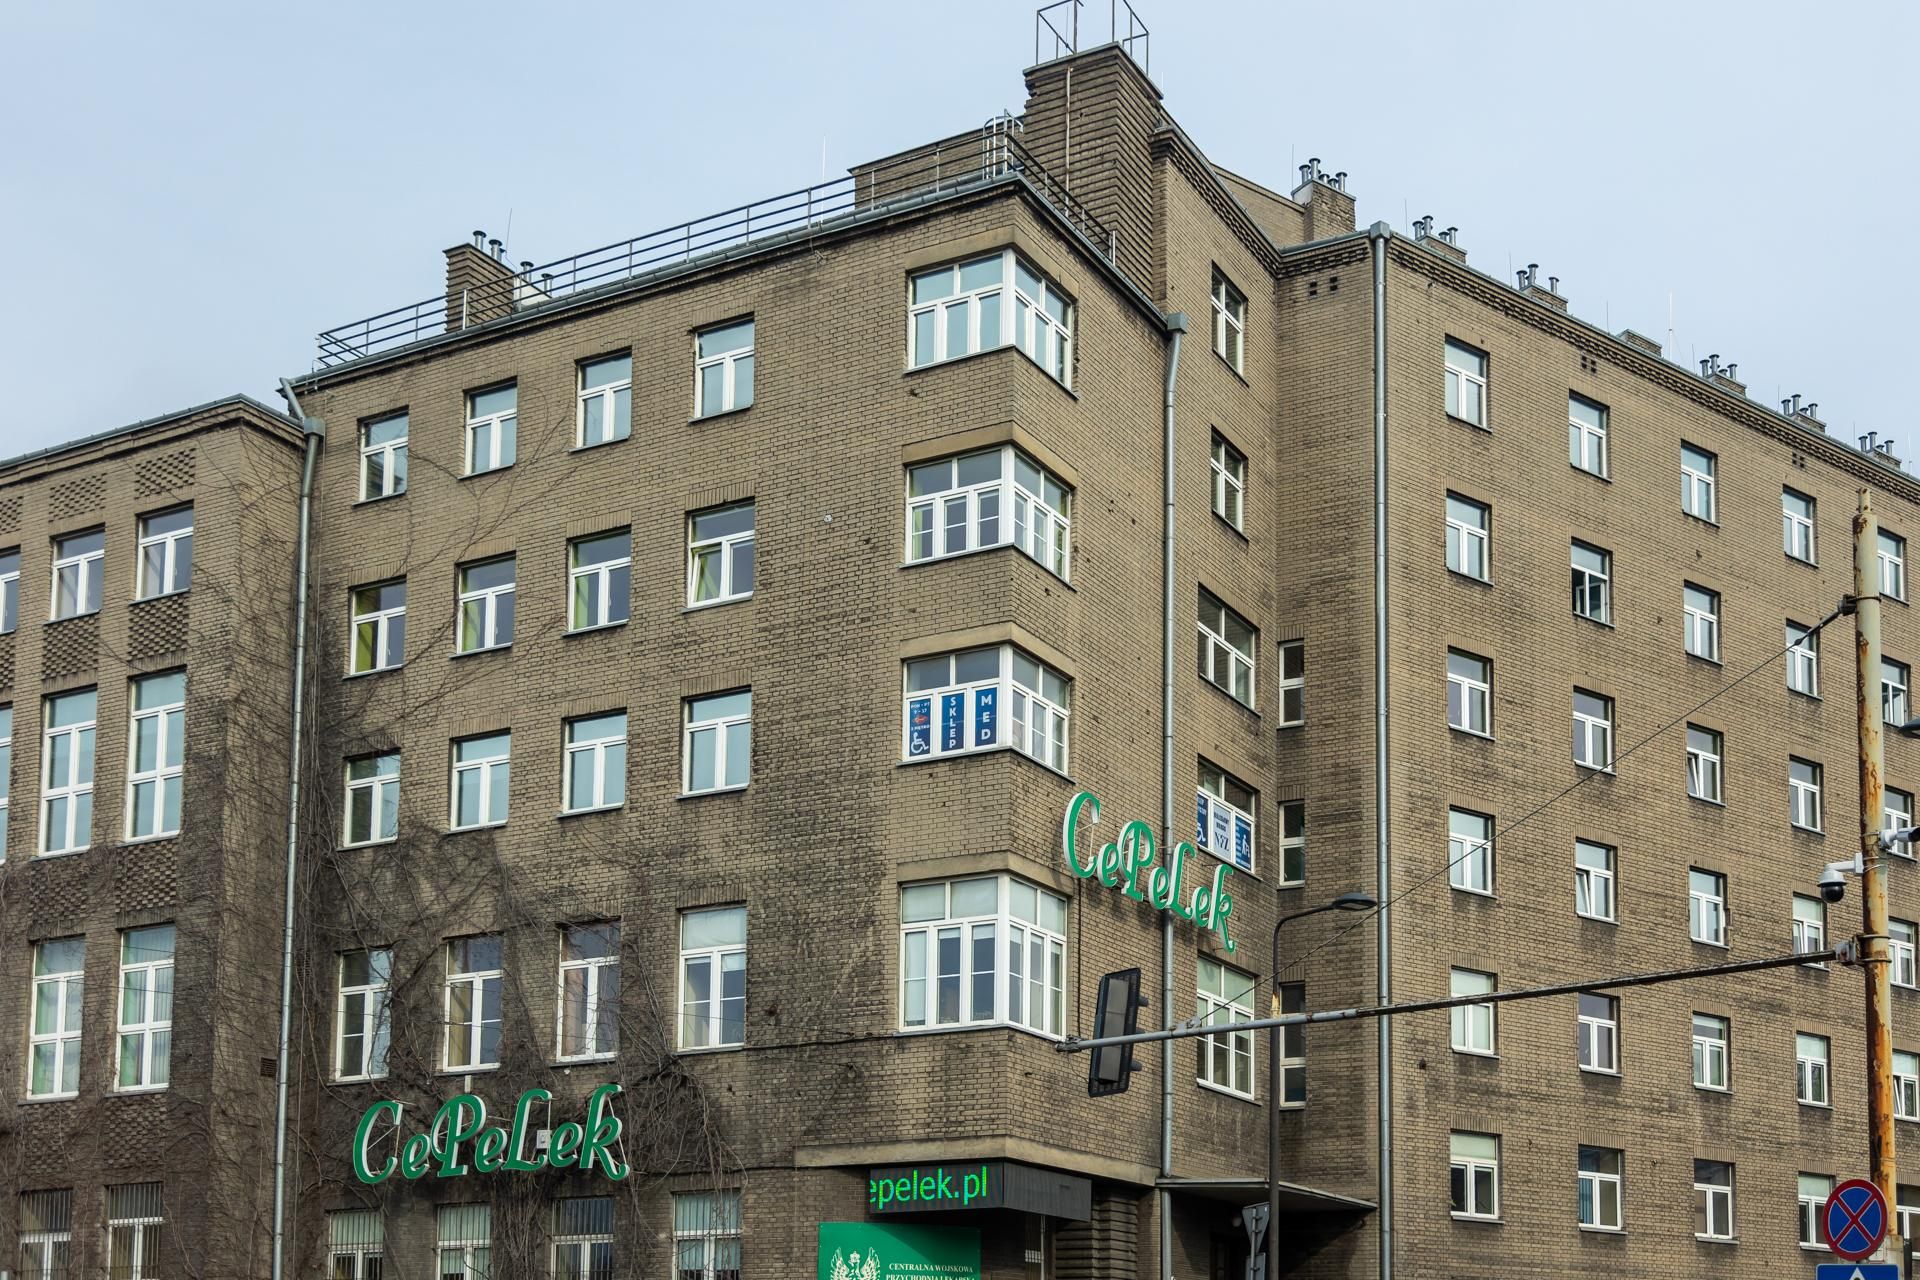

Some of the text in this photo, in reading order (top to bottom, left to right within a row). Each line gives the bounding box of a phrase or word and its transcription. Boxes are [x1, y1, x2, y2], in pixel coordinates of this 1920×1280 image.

[949, 697, 957, 748] SKLEP
[981, 694, 992, 740] MED
[1063, 791, 1236, 953] CePeLek
[353, 1084, 630, 1185] CePeLek
[889, 1263, 974, 1273] CENTRALNA WOJSKOWA
